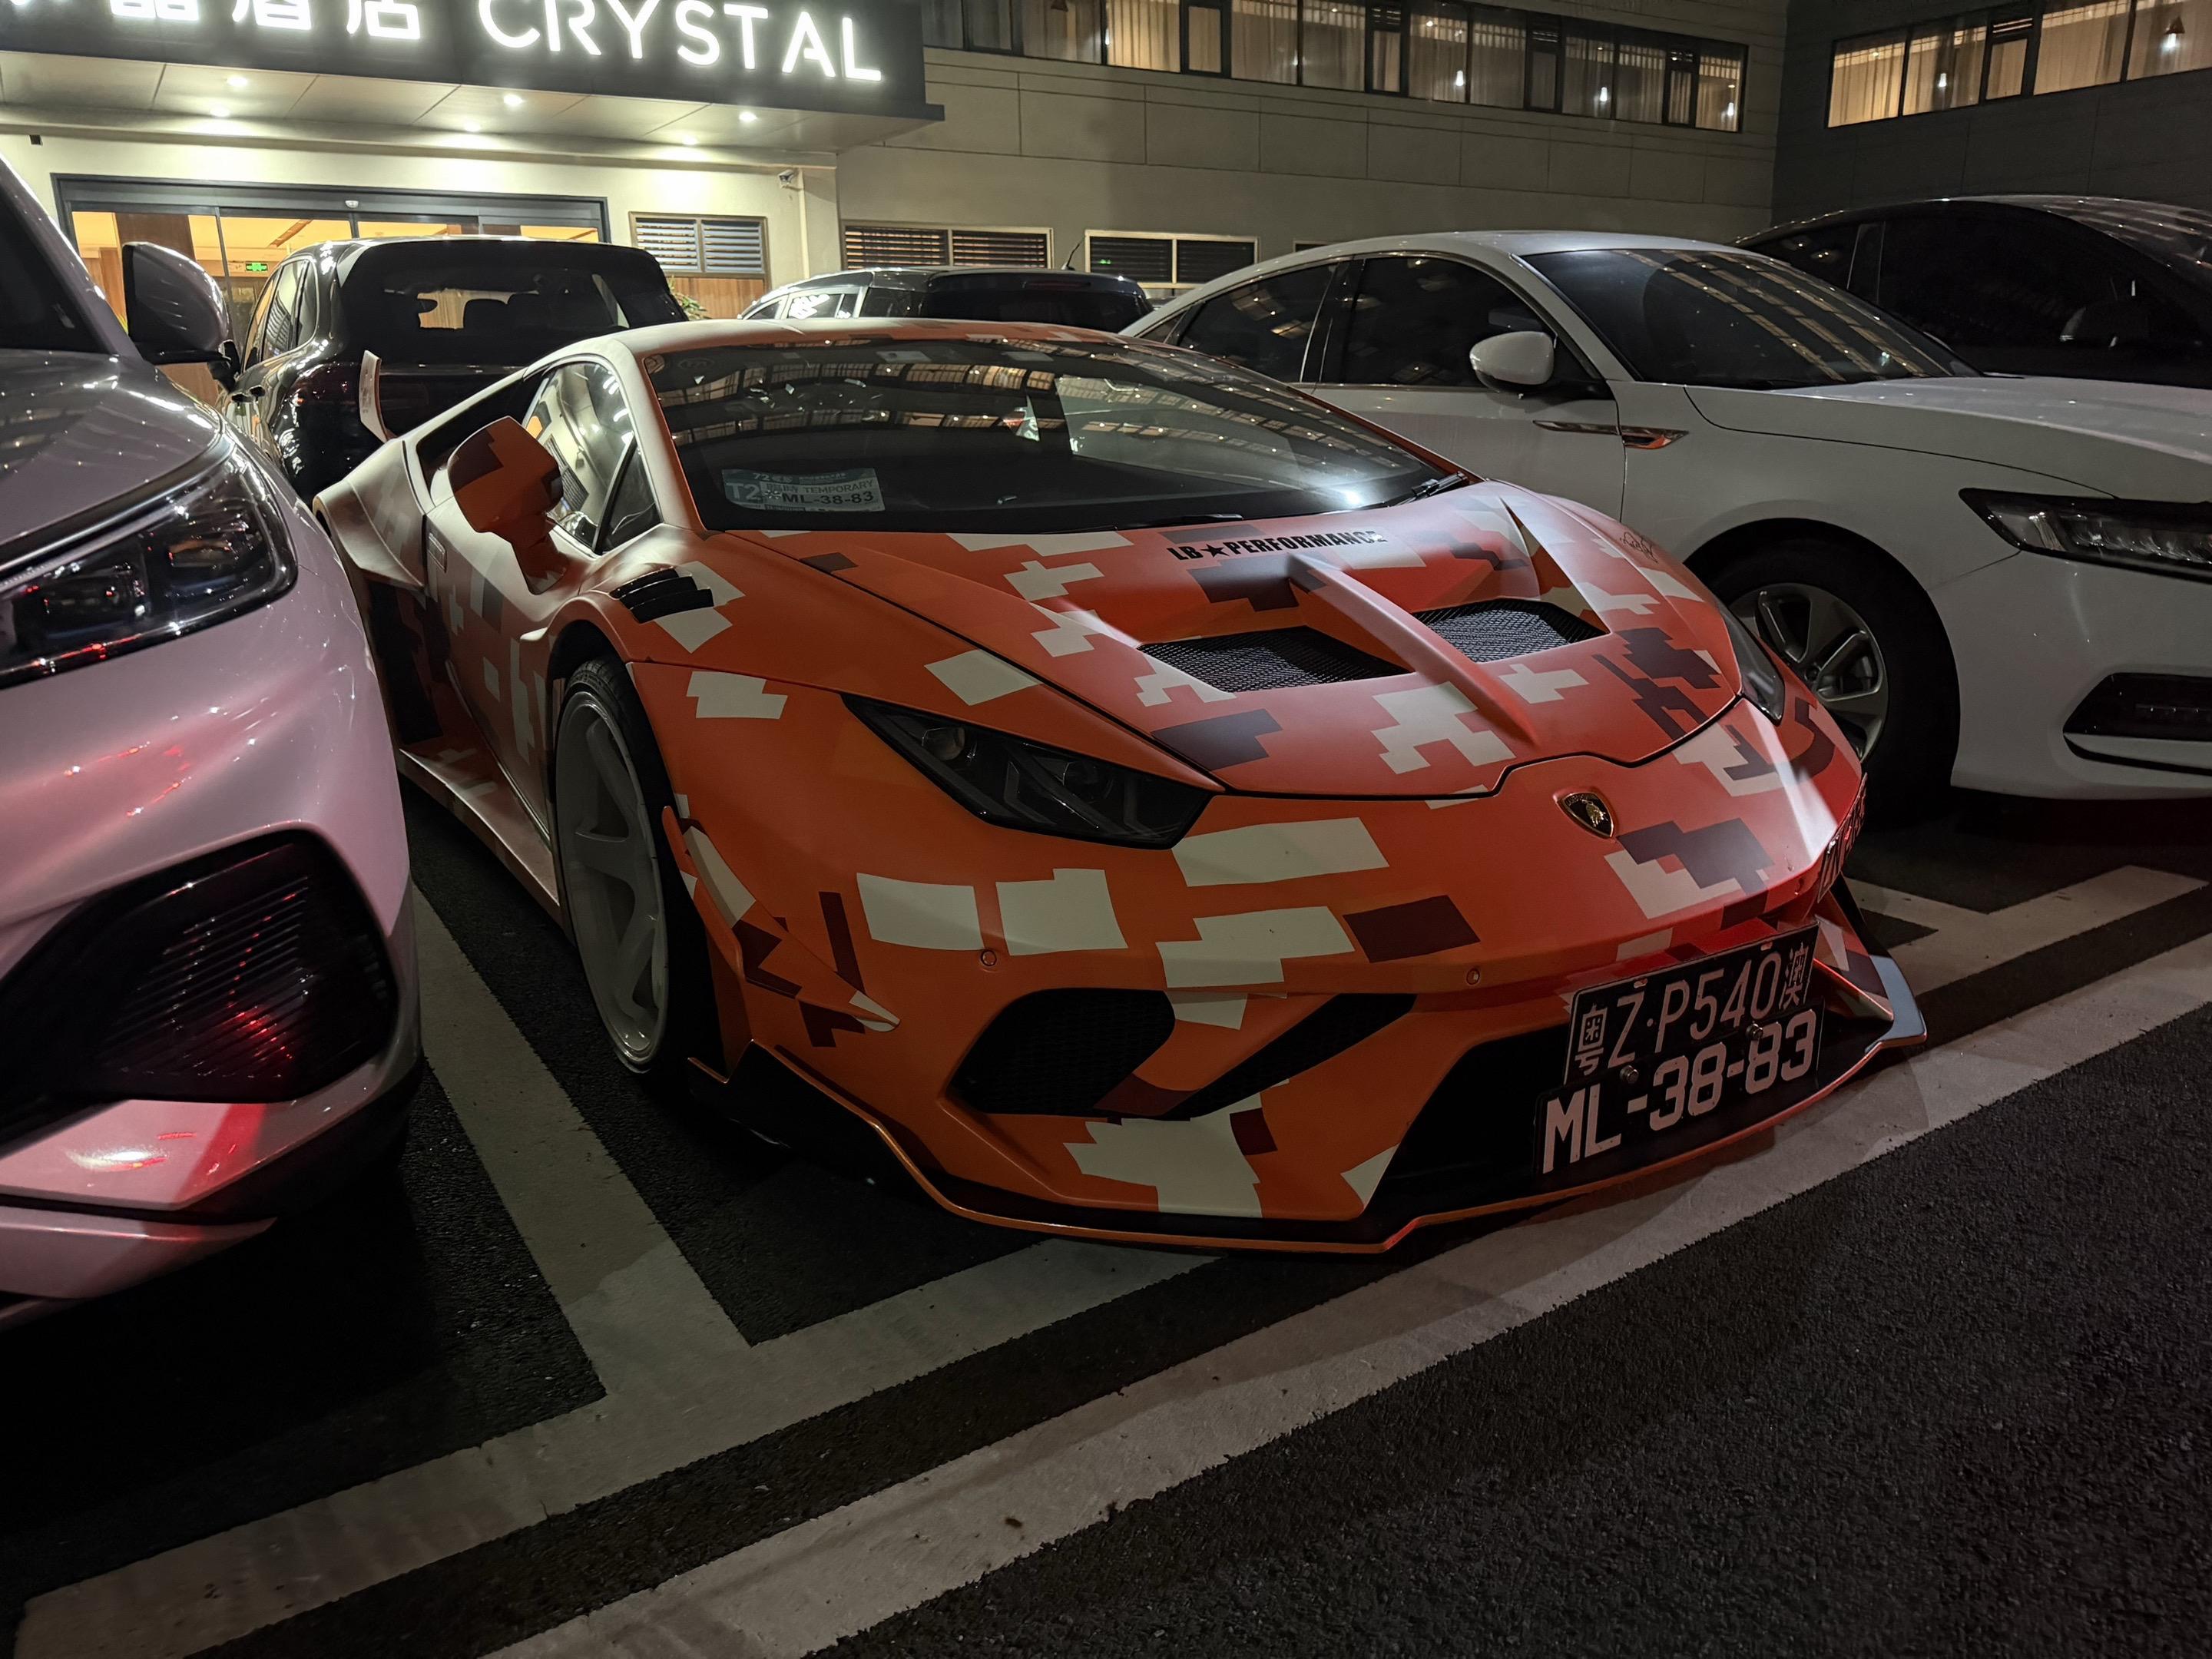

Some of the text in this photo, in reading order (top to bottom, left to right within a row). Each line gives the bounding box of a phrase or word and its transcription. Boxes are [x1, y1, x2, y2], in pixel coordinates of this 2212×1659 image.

[478, 0, 882, 81] CRYSTAL
[727, 482, 761, 502] T2
[803, 478, 874, 493] TEMPORARY
[783, 491, 874, 504] ML-38-83
[1542, 1008, 1817, 1174] ML-38-83
